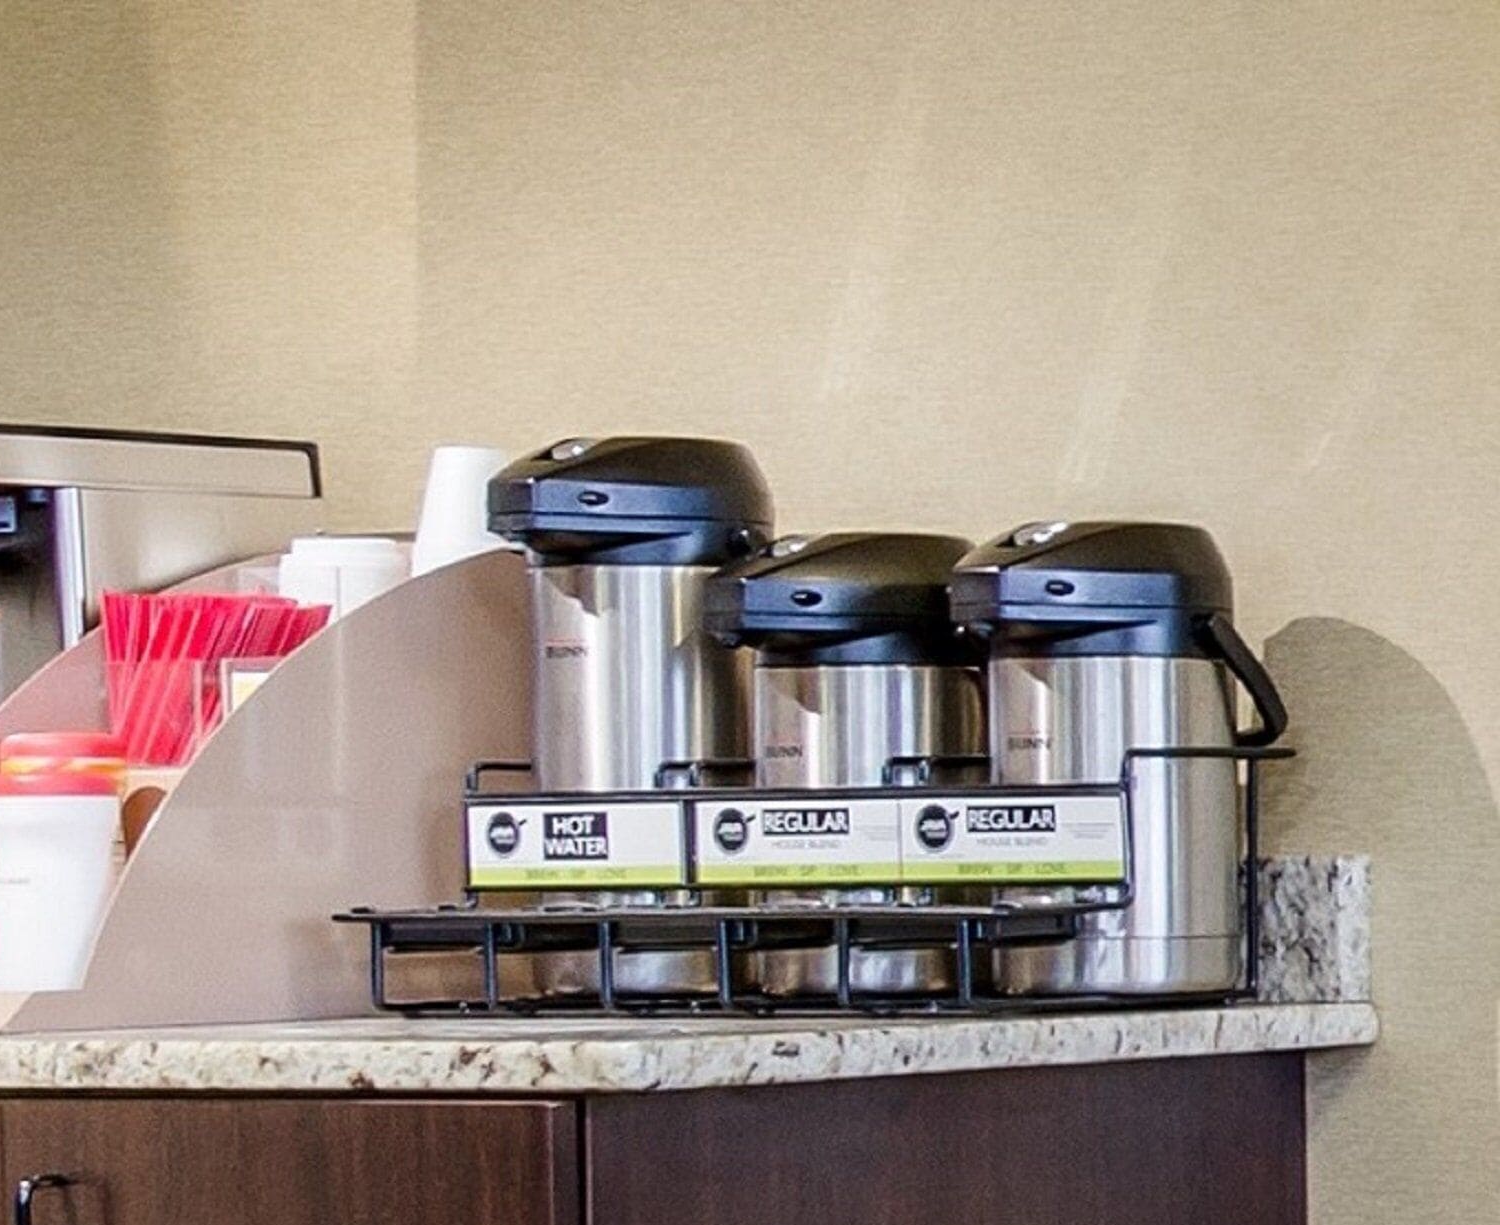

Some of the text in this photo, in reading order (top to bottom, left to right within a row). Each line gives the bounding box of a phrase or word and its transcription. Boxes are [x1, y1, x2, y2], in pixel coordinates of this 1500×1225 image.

[551, 815, 595, 836] HOT
[763, 810, 849, 833] REGULAR
[966, 808, 1054, 830] REGULAR
[544, 837, 608, 856] WATER
